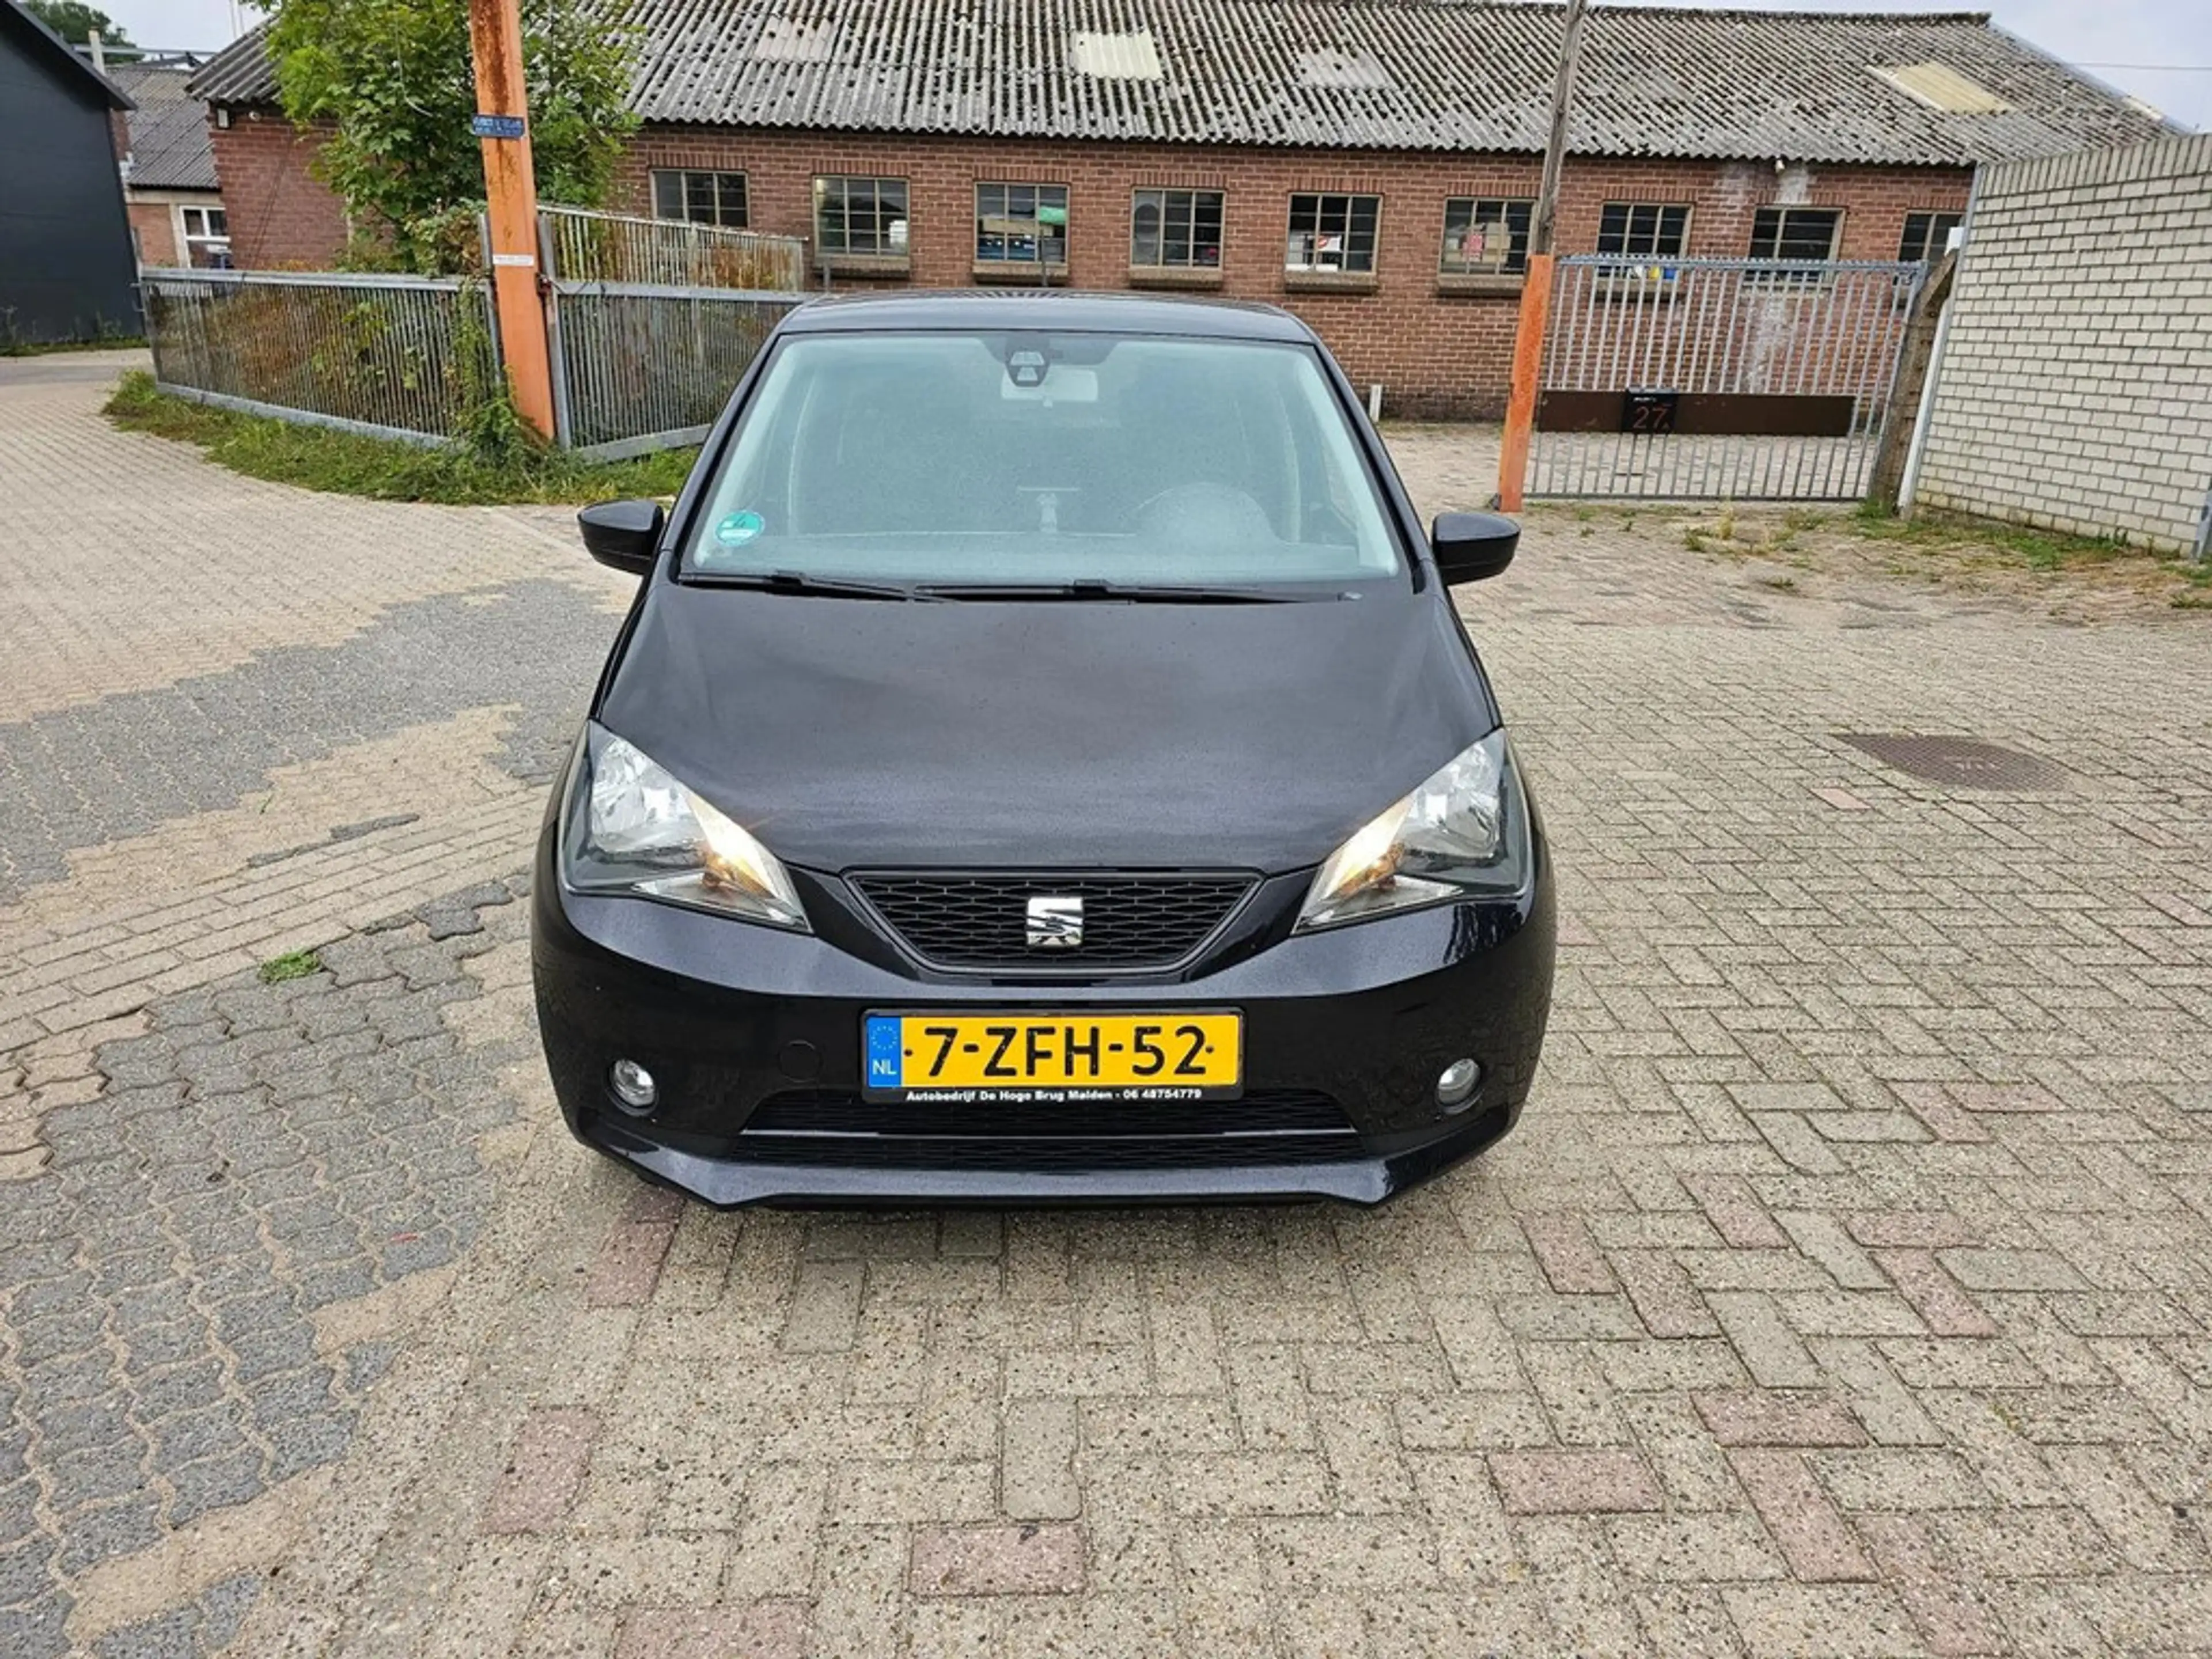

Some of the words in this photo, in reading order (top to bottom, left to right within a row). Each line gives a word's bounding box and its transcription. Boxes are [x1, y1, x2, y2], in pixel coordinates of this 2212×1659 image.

[1633, 406, 1668, 429] 27
[924, 1025, 1206, 1077] 7-ZFH-52
[873, 1059, 897, 1075] NL
[906, 1090, 976, 1103] Autobedrijf
[980, 1090, 997, 1101] De
[999, 1090, 1032, 1103] Hoge
[1035, 1090, 1065, 1102] Brug
[1123, 1088, 1139, 1099] 06
